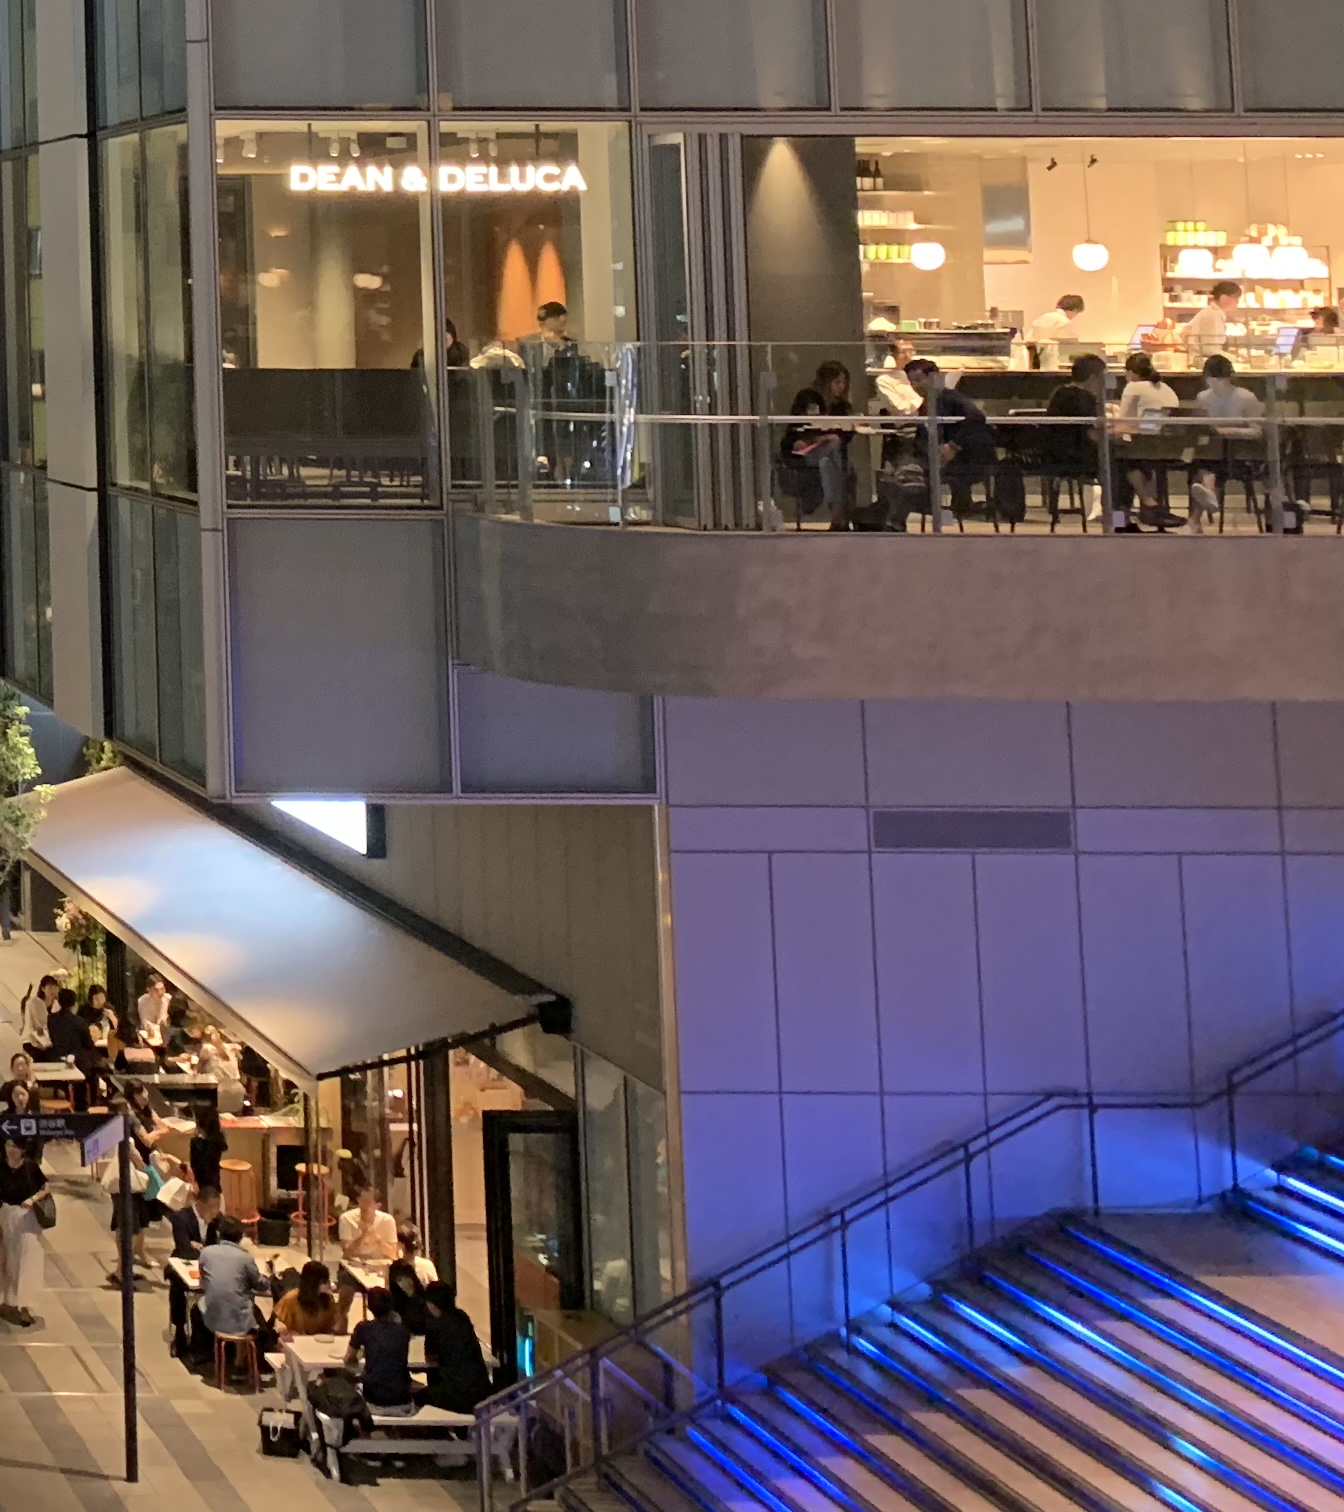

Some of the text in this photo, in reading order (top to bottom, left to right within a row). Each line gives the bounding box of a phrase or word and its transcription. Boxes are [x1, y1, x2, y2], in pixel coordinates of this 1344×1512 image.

[290, 164, 588, 192] DEAN & DELUCA
